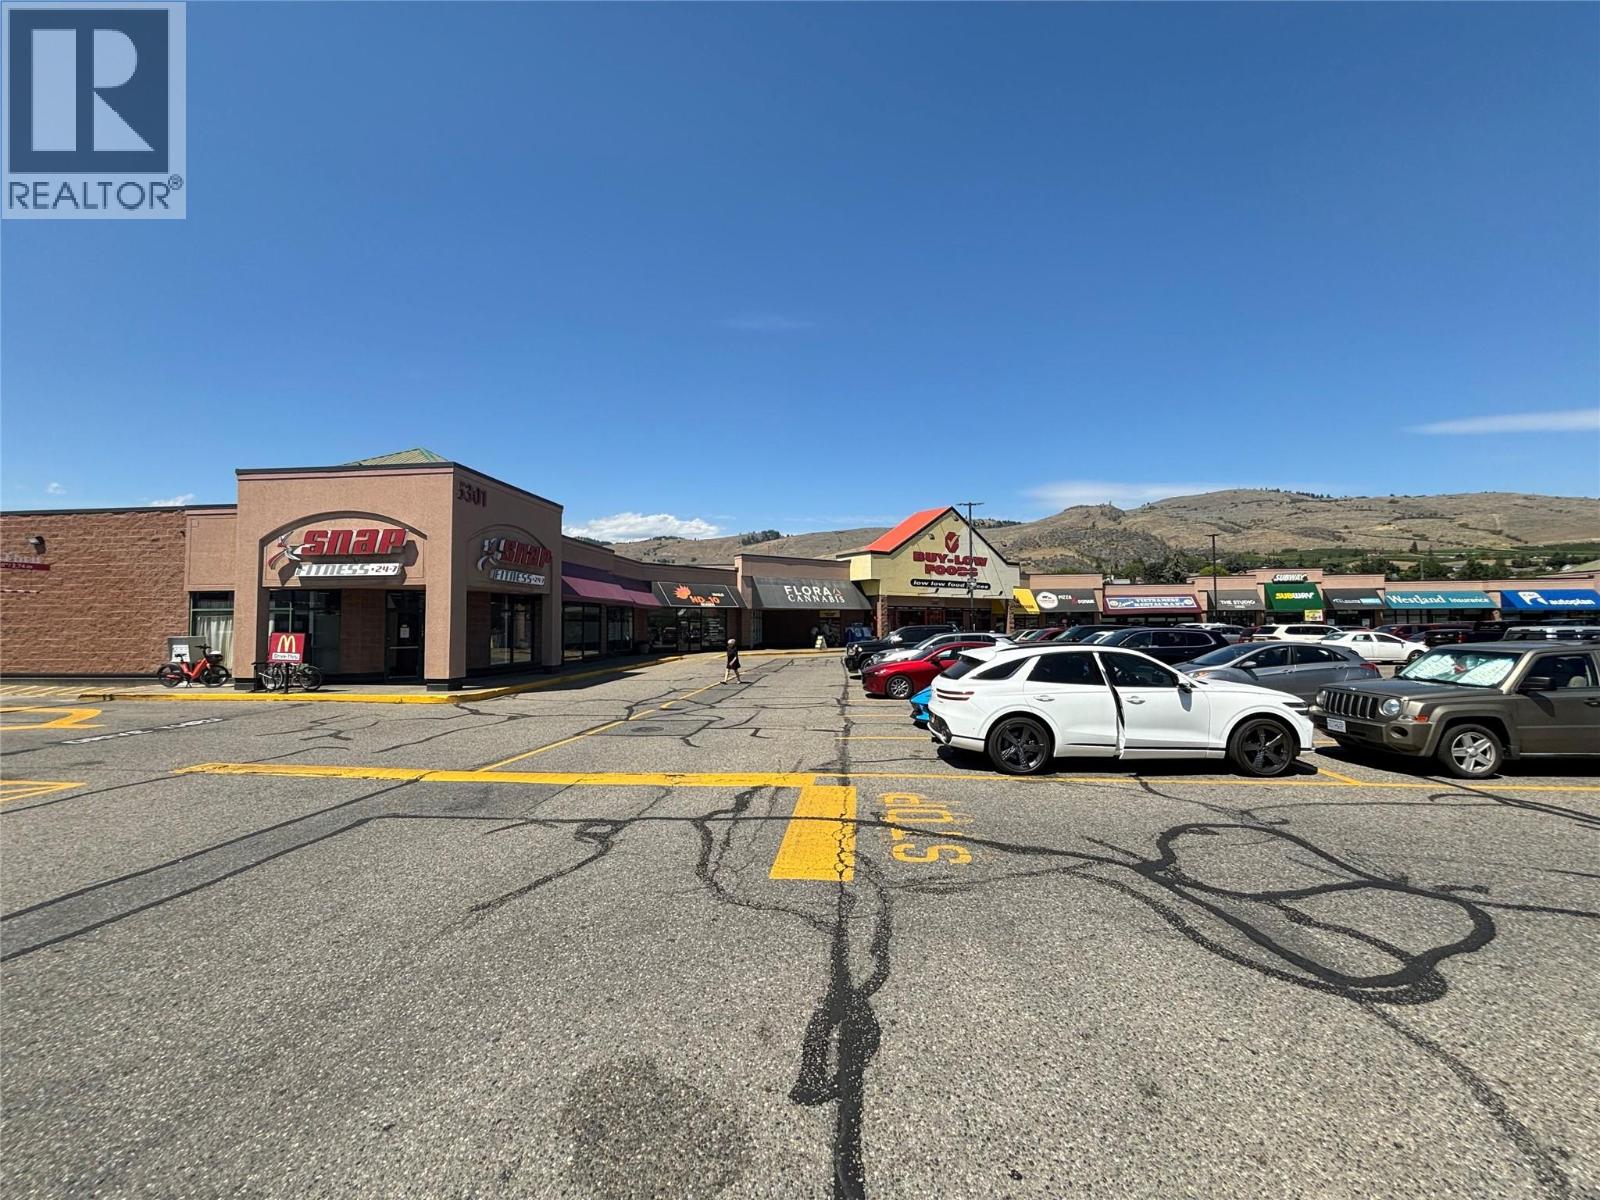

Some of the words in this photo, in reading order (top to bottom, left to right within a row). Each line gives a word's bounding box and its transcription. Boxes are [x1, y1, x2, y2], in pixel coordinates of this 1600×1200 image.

[456, 481, 488, 508] 5301
[912, 551, 988, 567] BUY-LOW
[924, 563, 979, 577] FOODS
[783, 585, 832, 596] FLORA
[1275, 592, 1315, 600] SUBWAY
[787, 594, 846, 604] CANNABIS
[1387, 594, 1446, 605] Westland
